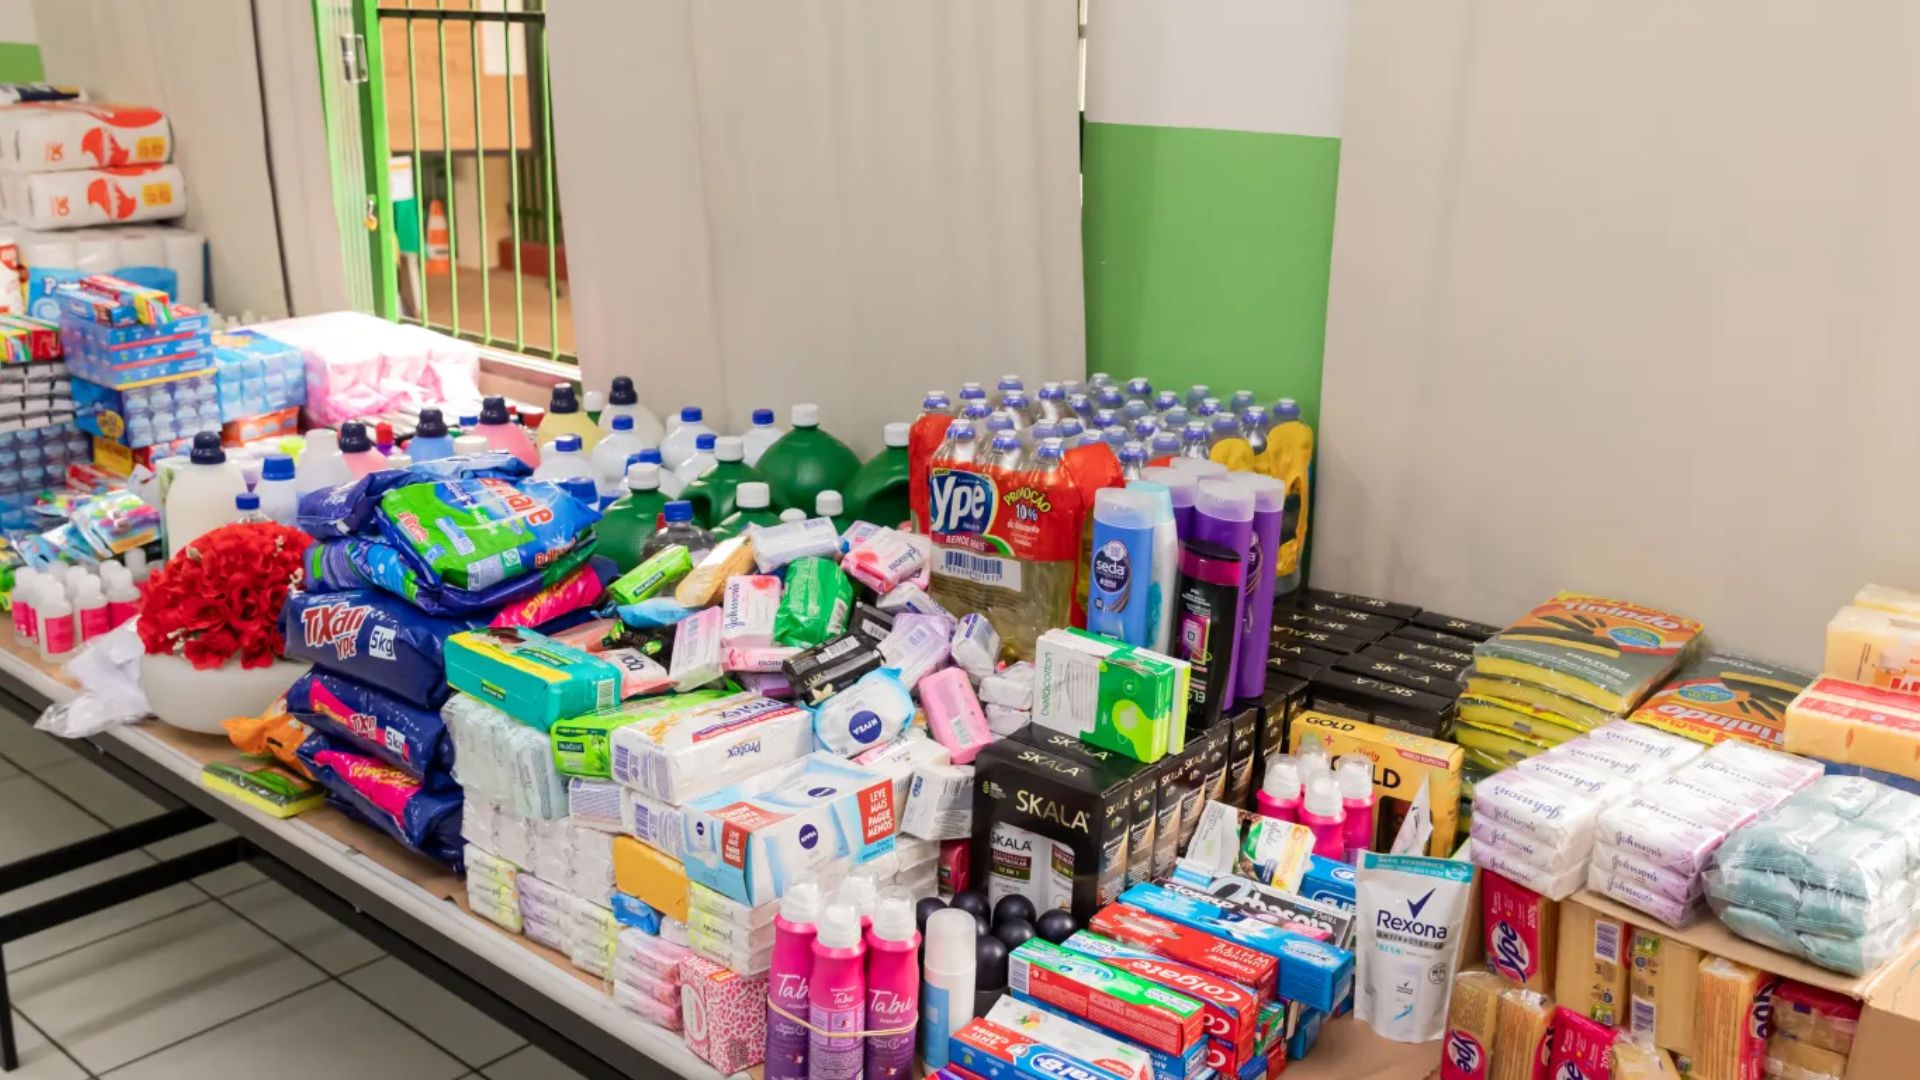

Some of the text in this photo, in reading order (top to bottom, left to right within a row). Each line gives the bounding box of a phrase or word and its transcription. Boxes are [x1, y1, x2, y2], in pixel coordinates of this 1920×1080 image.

[1096, 560, 1126, 576] seda
[371, 631, 394, 657] 5kg
[804, 673, 827, 687] LUX
[852, 717, 878, 735] NIVEA
[1305, 716, 1356, 732] GOLD
[727, 741, 761, 759] Protex
[1017, 751, 1082, 777] SKALA
[1536, 763, 1607, 792] Johnson's
[870, 788, 887, 802] LEVE
[870, 800, 888, 813] MAIS
[1494, 785, 1566, 820] Johnson's
[867, 810, 891, 828] PAGUE
[1016, 789, 1090, 834] SKALA
[867, 819, 893, 839] MENOS
[1612, 855, 1658, 883] Johnson's
[1376, 909, 1449, 939] Rexona
[777, 973, 810, 1000] Tab
[1132, 959, 1242, 1003] Colgate
[869, 988, 914, 1015] Tabu
